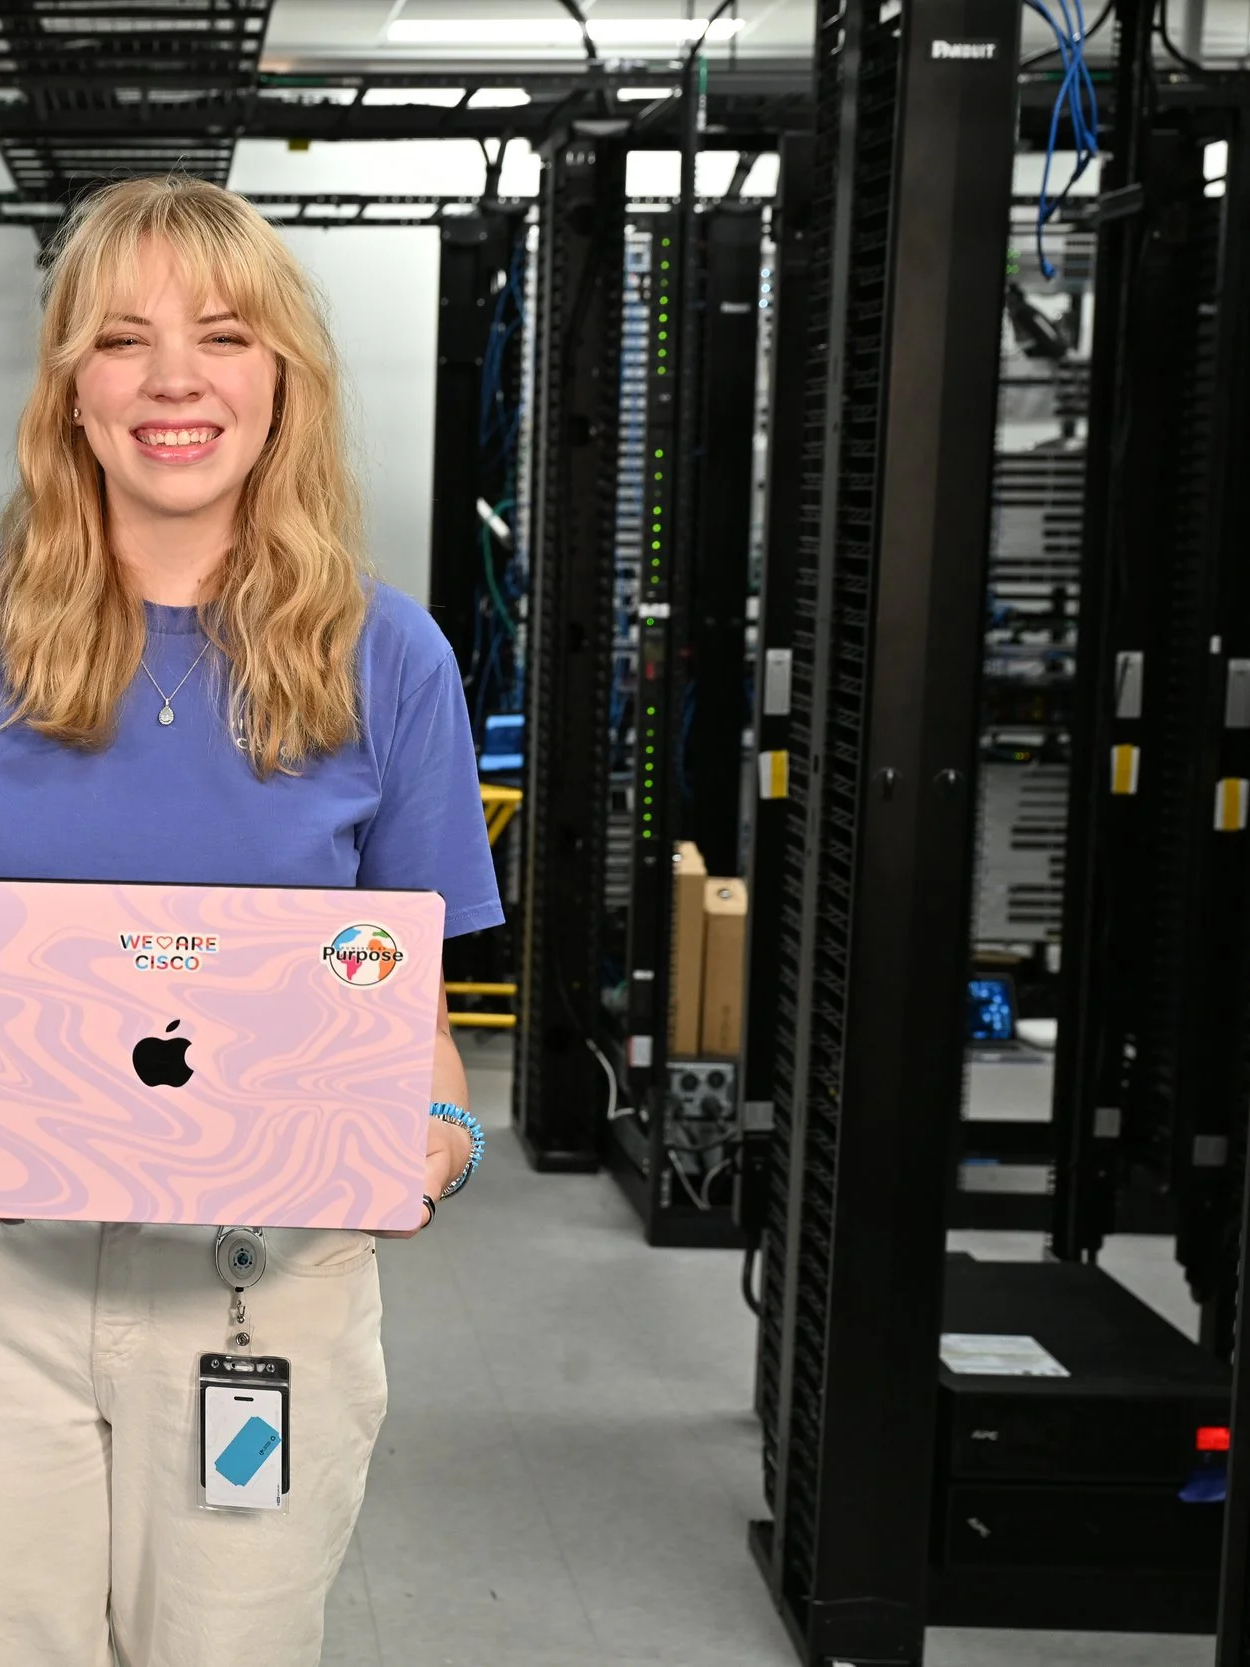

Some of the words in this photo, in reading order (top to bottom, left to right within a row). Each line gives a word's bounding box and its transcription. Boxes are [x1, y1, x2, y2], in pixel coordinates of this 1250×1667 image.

[120, 934, 153, 950] WE
[175, 936, 217, 951] ARE
[135, 955, 200, 970] CISCO
[322, 946, 404, 965] Purpose
